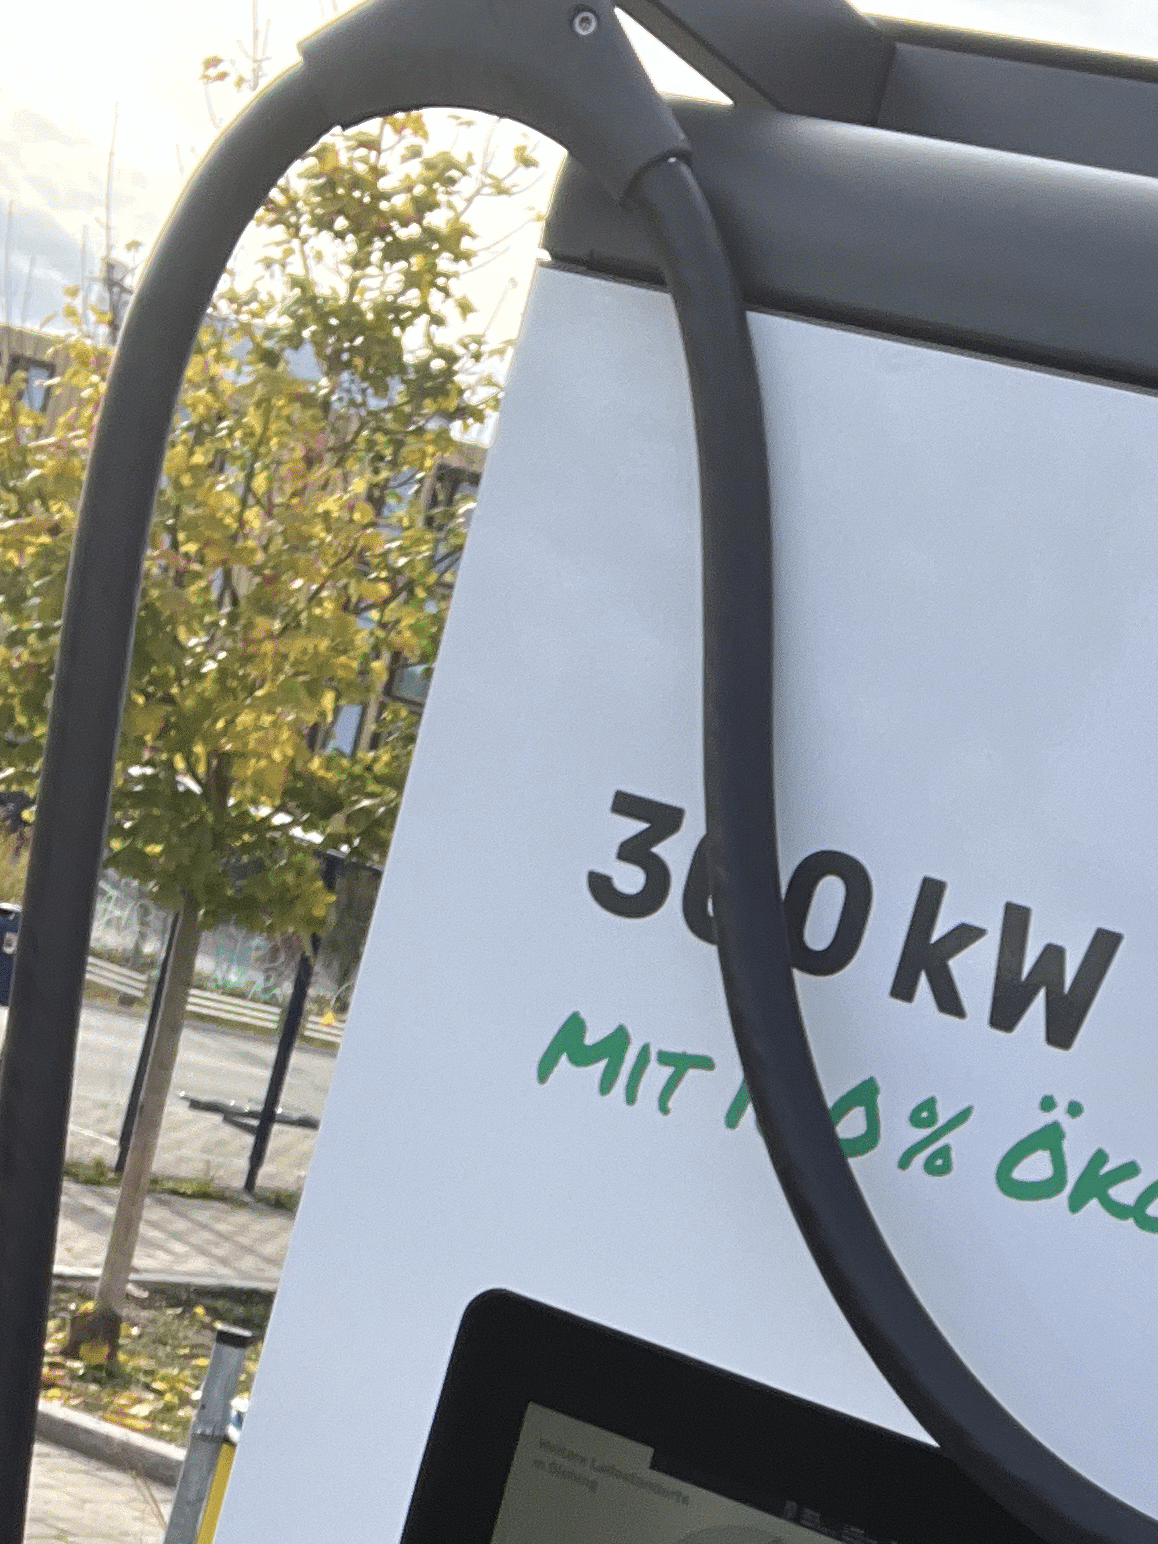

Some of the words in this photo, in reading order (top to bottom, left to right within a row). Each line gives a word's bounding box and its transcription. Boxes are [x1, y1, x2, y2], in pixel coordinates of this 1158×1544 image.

[889, 876, 1125, 1052] kW
[537, 1011, 715, 1116] MIT
[724, 1077, 974, 1177] 10%
